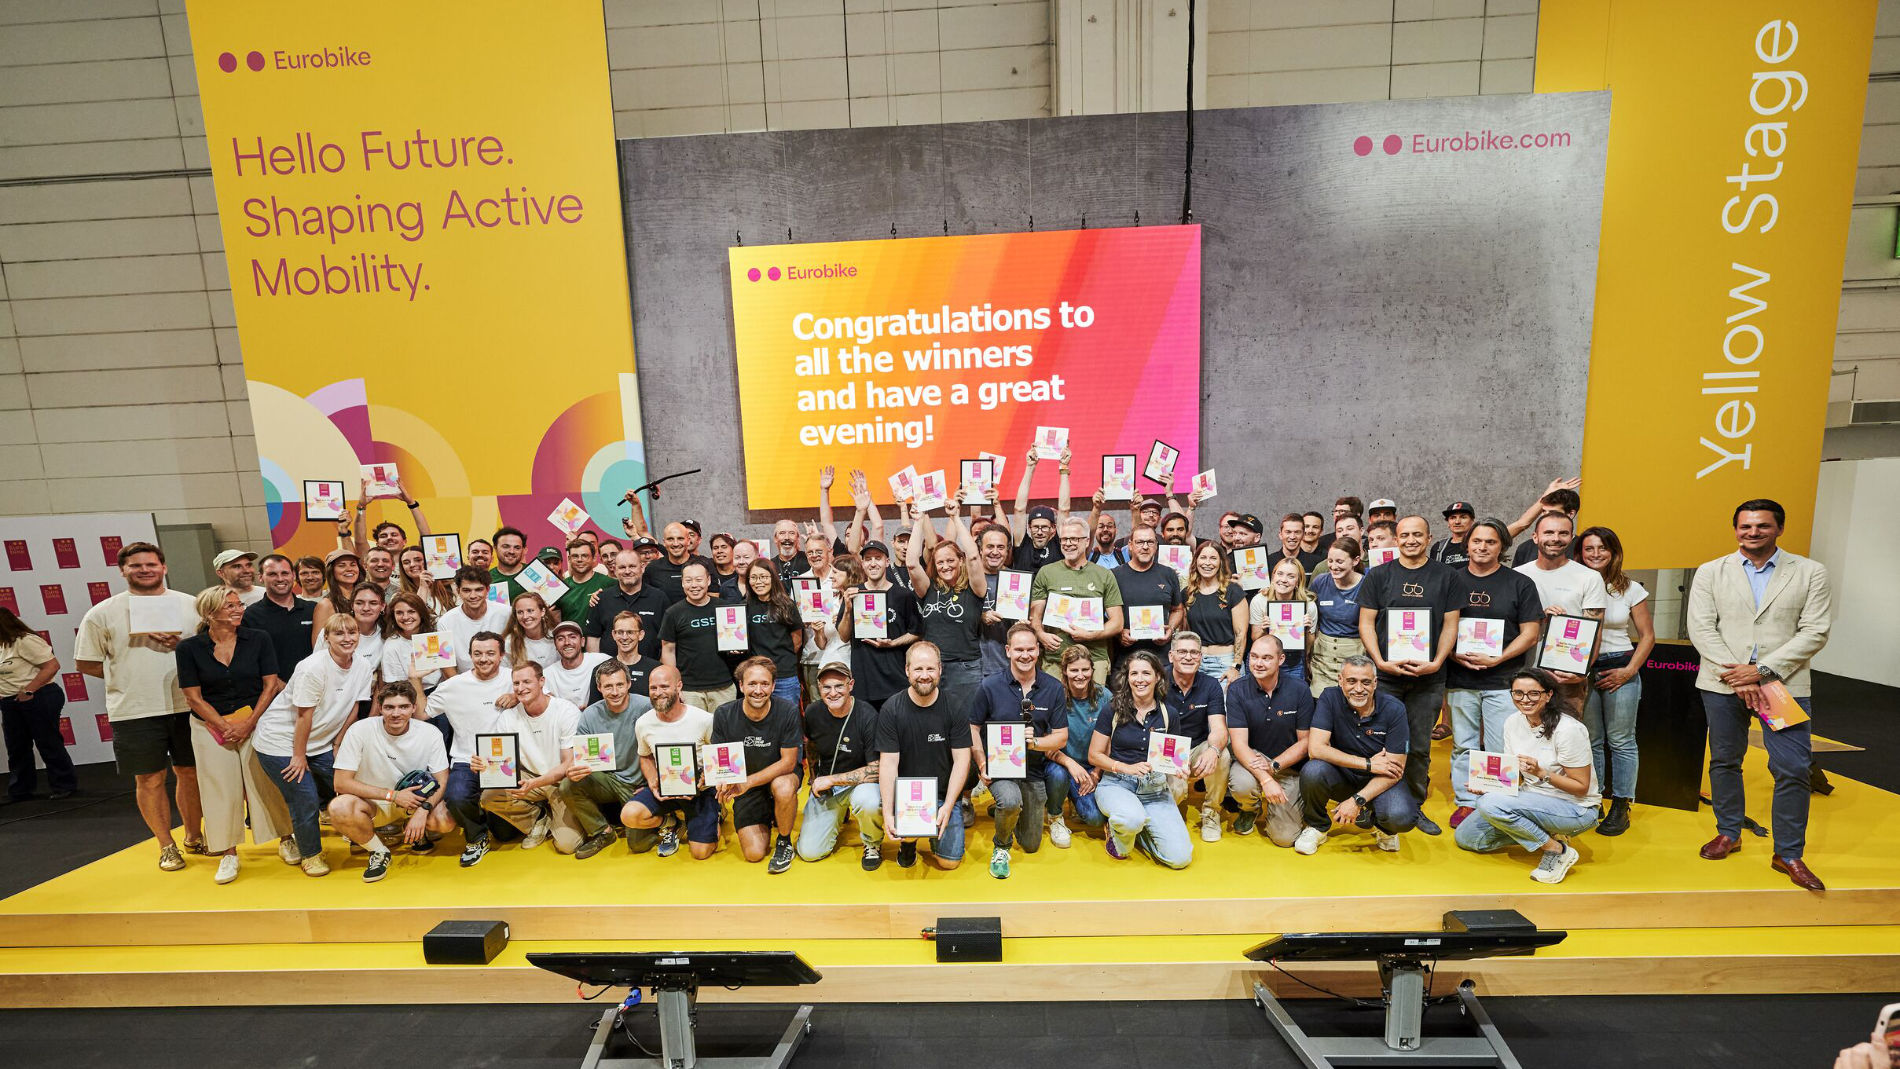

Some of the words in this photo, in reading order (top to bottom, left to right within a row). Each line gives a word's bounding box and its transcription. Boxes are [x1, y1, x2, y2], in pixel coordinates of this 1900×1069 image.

[274, 47, 371, 70] Eurobike
[1412, 130, 1571, 154] Eurobike.com
[1721, 19, 1809, 234] Stage
[232, 132, 346, 177] Hello
[361, 129, 514, 171] Future.
[243, 194, 425, 245] Shaping
[442, 186, 584, 230] Active
[251, 253, 430, 301] Mobility.
[787, 263, 858, 280] Eurobike
[792, 303, 1051, 344] Congratulations
[1058, 301, 1095, 329] to
[795, 347, 830, 377] all
[838, 346, 894, 374] the
[903, 341, 1033, 372] winners
[1696, 262, 1771, 479] Yellow
[797, 381, 856, 412] and
[866, 380, 942, 409] have
[950, 383, 969, 405] a
[978, 375, 1065, 410] great
[799, 415, 934, 448] evening!
